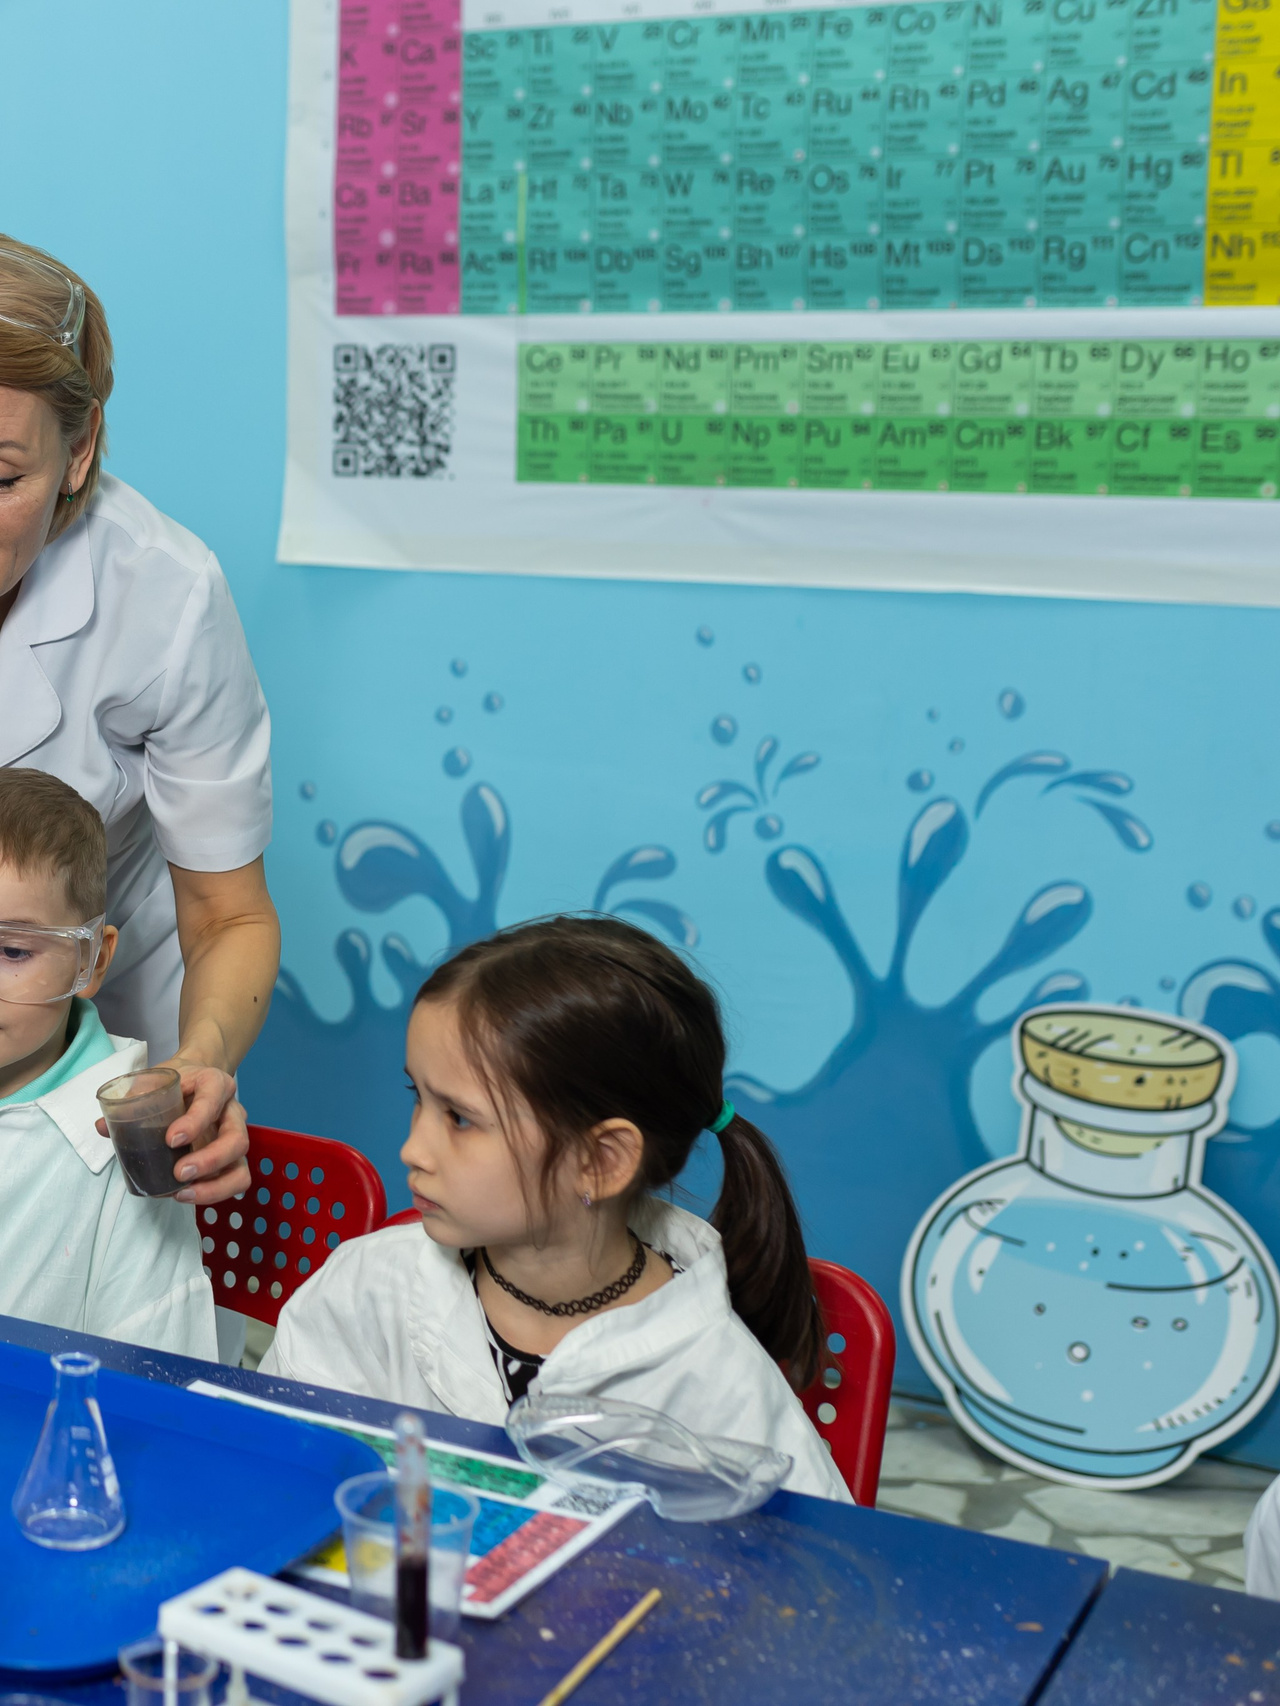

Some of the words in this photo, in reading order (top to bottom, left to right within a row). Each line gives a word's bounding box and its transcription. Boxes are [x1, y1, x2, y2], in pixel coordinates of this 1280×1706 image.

[818, 13, 853, 38] Fe
[893, 6, 936, 35] Co
[972, 3, 1001, 29] Ni
[1052, 0, 1095, 24] Cu
[530, 30, 553, 57] Ti
[598, 27, 618, 53] V
[669, 21, 701, 49] Cr
[743, 19, 785, 44] Mn
[401, 39, 436, 65] Ca
[465, 35, 497, 60] Sc
[967, 80, 1006, 108] Pd
[1046, 77, 1090, 109] Ag
[1130, 70, 1177, 101] Cd
[1218, 68, 1248, 96] In
[597, 100, 633, 127] Nb
[666, 98, 708, 123] Mo
[741, 93, 771, 120] Tc
[813, 89, 852, 116] Ru
[464, 108, 482, 131] Y
[529, 103, 556, 131] Zr
[737, 169, 775, 195] Re
[809, 166, 850, 194] Os
[887, 165, 905, 190] Ir
[964, 161, 997, 187] Pt
[1042, 157, 1086, 185] Au
[1127, 153, 1174, 188] Hg
[336, 183, 369, 209] Cs
[400, 181, 432, 207] Ba
[463, 179, 494, 204] La
[600, 174, 627, 201] Ta
[664, 171, 694, 198] W
[810, 244, 848, 270] Hs
[885, 242, 921, 268] Mt
[963, 238, 1002, 266] Ds
[1042, 235, 1087, 270] Rg
[1124, 233, 1170, 263] Cn
[1210, 232, 1256, 259] Nh
[400, 251, 433, 276] Ra
[464, 251, 496, 275] Ac
[596, 246, 633, 273] Db
[664, 245, 702, 277] Sg
[594, 346, 624, 372] Pr
[662, 347, 701, 372] Nd
[733, 345, 779, 372] Pm
[806, 345, 852, 372] Sm
[882, 345, 921, 372] Eu
[957, 345, 1002, 373] Gd
[1040, 344, 1080, 373] Tb
[1119, 344, 1166, 379] Dy
[1204, 344, 1252, 373] Ho
[525, 418, 560, 444] Th
[593, 419, 628, 445] Pa
[661, 420, 683, 445] U
[731, 421, 771, 450] Np
[804, 422, 841, 448] Pu
[877, 423, 926, 448] Am
[954, 423, 1004, 450] Cm
[1035, 423, 1073, 449] Bk
[1201, 424, 1242, 452] Es
